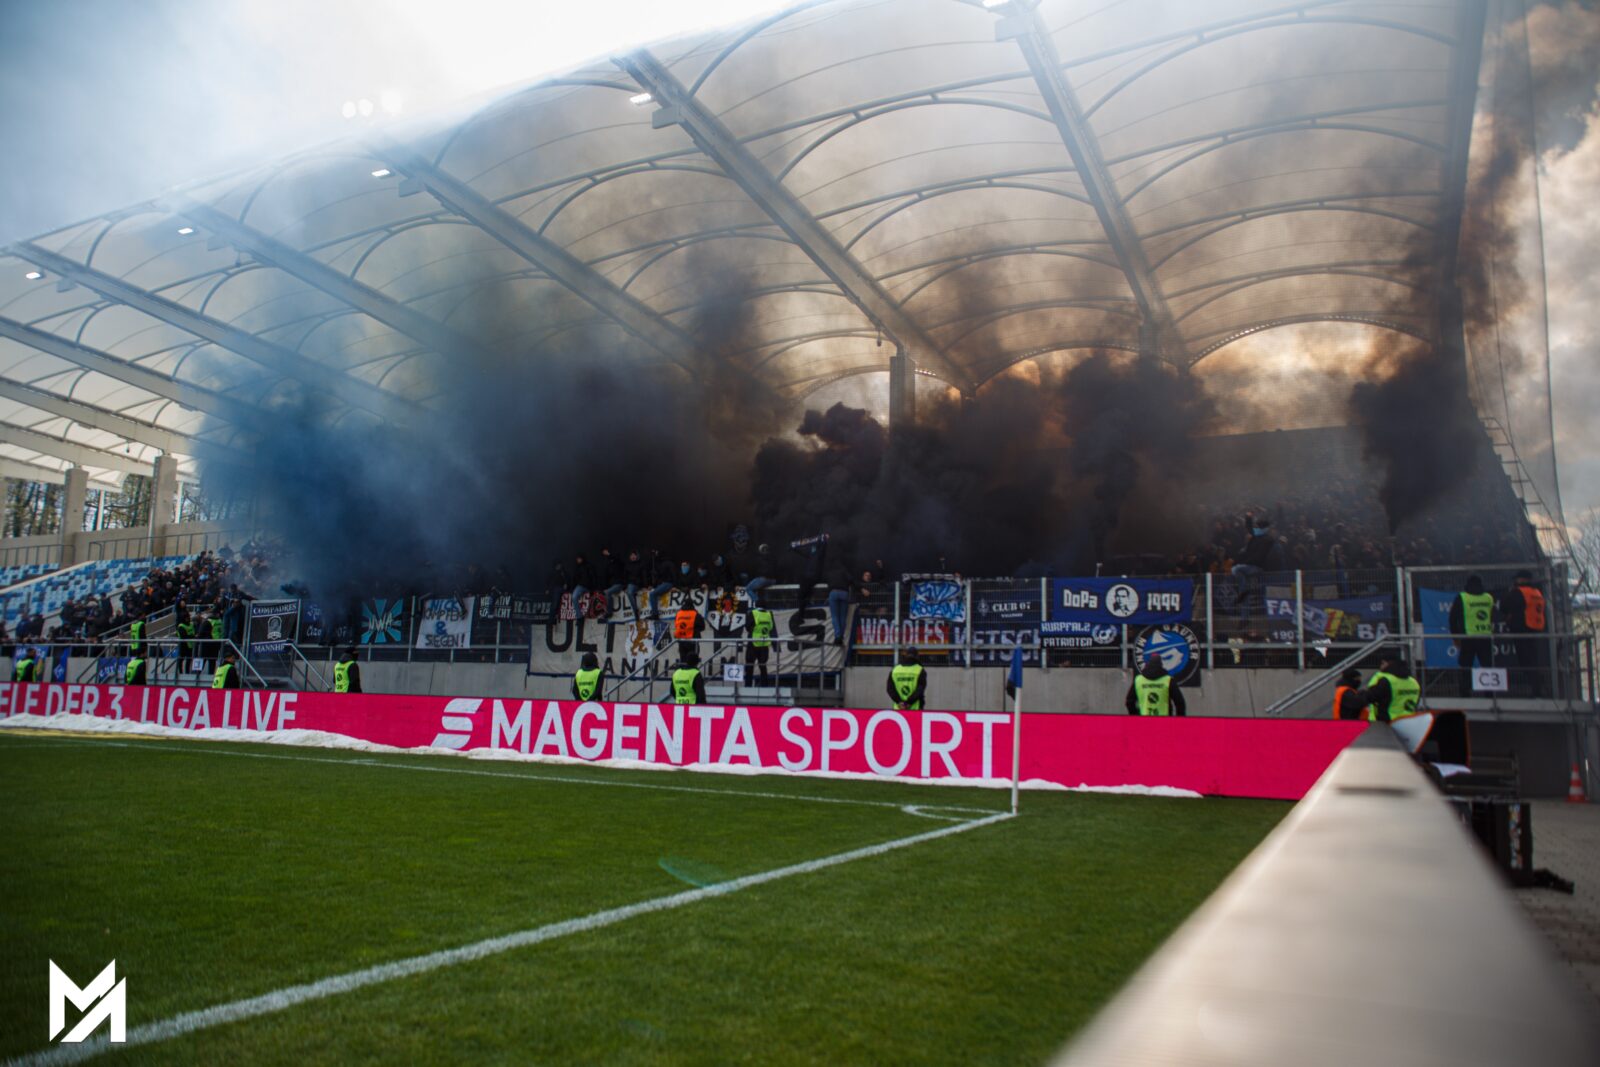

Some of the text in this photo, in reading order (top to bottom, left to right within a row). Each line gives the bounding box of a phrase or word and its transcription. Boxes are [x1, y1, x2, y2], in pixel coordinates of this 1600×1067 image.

[992, 602, 1018, 612] CLUB
[1063, 589, 1180, 612] DoPa 1999
[727, 668, 740, 678] C2
[1479, 672, 1500, 686] C3
[45, 684, 100, 717] DER
[141, 687, 211, 731] LIGA
[222, 690, 298, 732] LIVE
[490, 699, 762, 768] MAGENTA
[777, 708, 1011, 779] SPORT
